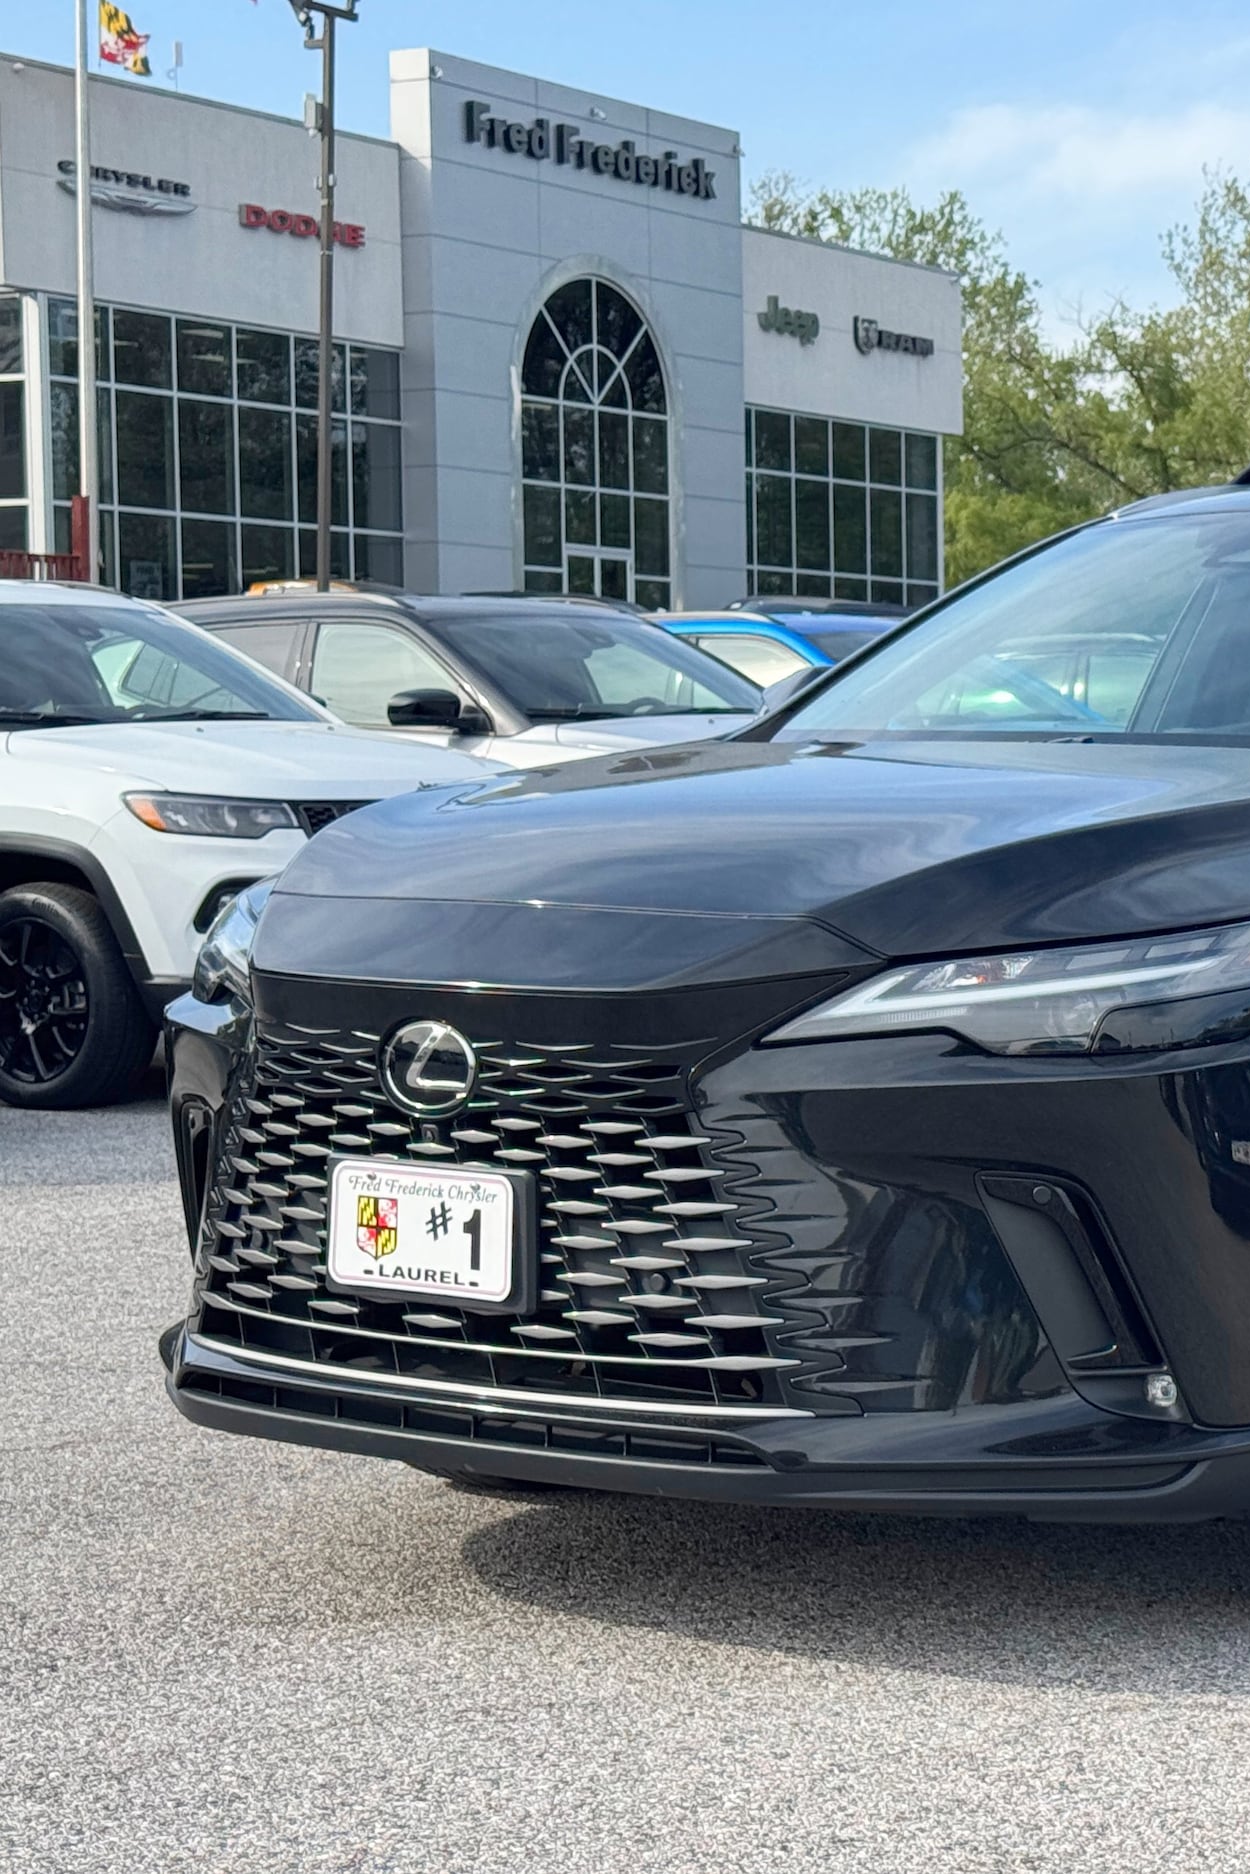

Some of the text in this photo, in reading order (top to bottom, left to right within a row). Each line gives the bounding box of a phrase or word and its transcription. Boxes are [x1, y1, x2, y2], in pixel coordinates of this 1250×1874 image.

[464, 100, 717, 200] Fred Frederick
[757, 295, 820, 347] Jeep
[877, 329, 935, 358] RAM
[349, 1174, 498, 1204] Fred Frederick Chrysler
[379, 1263, 466, 1287] LAUREL
